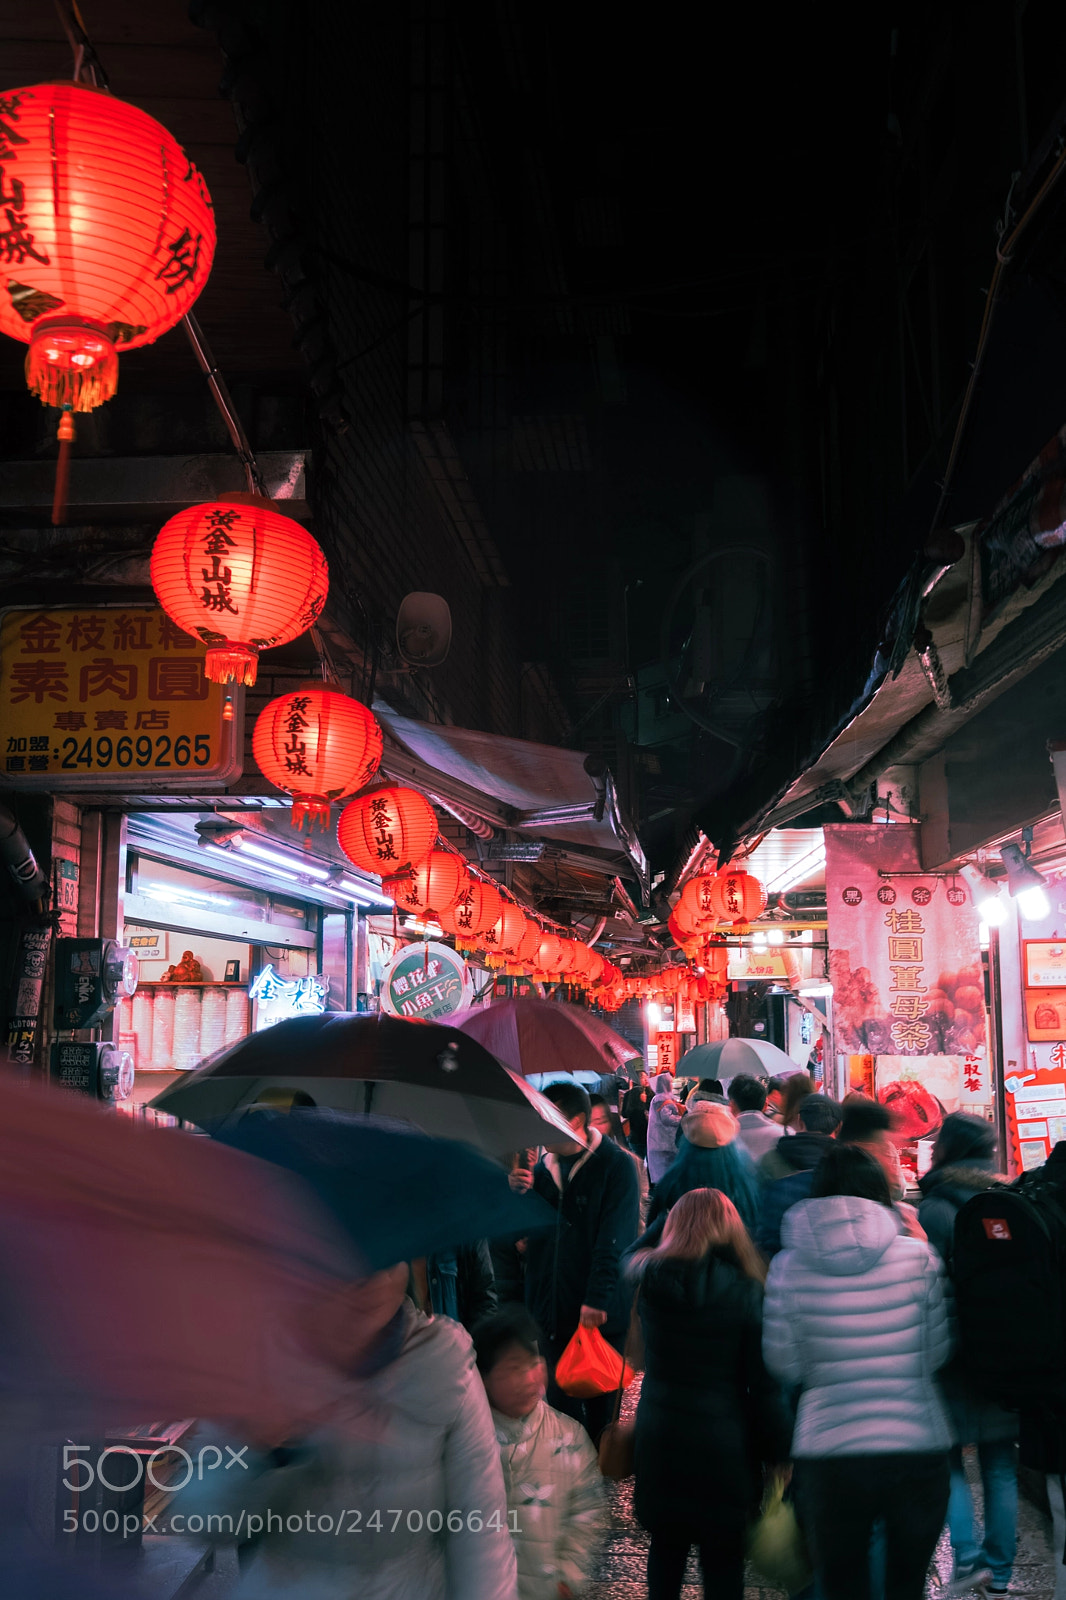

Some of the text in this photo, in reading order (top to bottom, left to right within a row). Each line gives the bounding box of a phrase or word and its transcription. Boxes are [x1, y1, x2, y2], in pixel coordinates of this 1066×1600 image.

[200, 509, 241, 615] 黃金山城
[10, 657, 209, 704] 素肉圓
[7, 736, 50, 752] 加盟
[53, 710, 170, 731] 專賣店
[283, 697, 313, 777] 黃金山城
[6, 755, 49, 772] 直營
[368, 798, 399, 861] 黃金山城
[726, 879, 740, 914] 黃金山城
[884, 908, 931, 1049] 桂圓薑母茶
